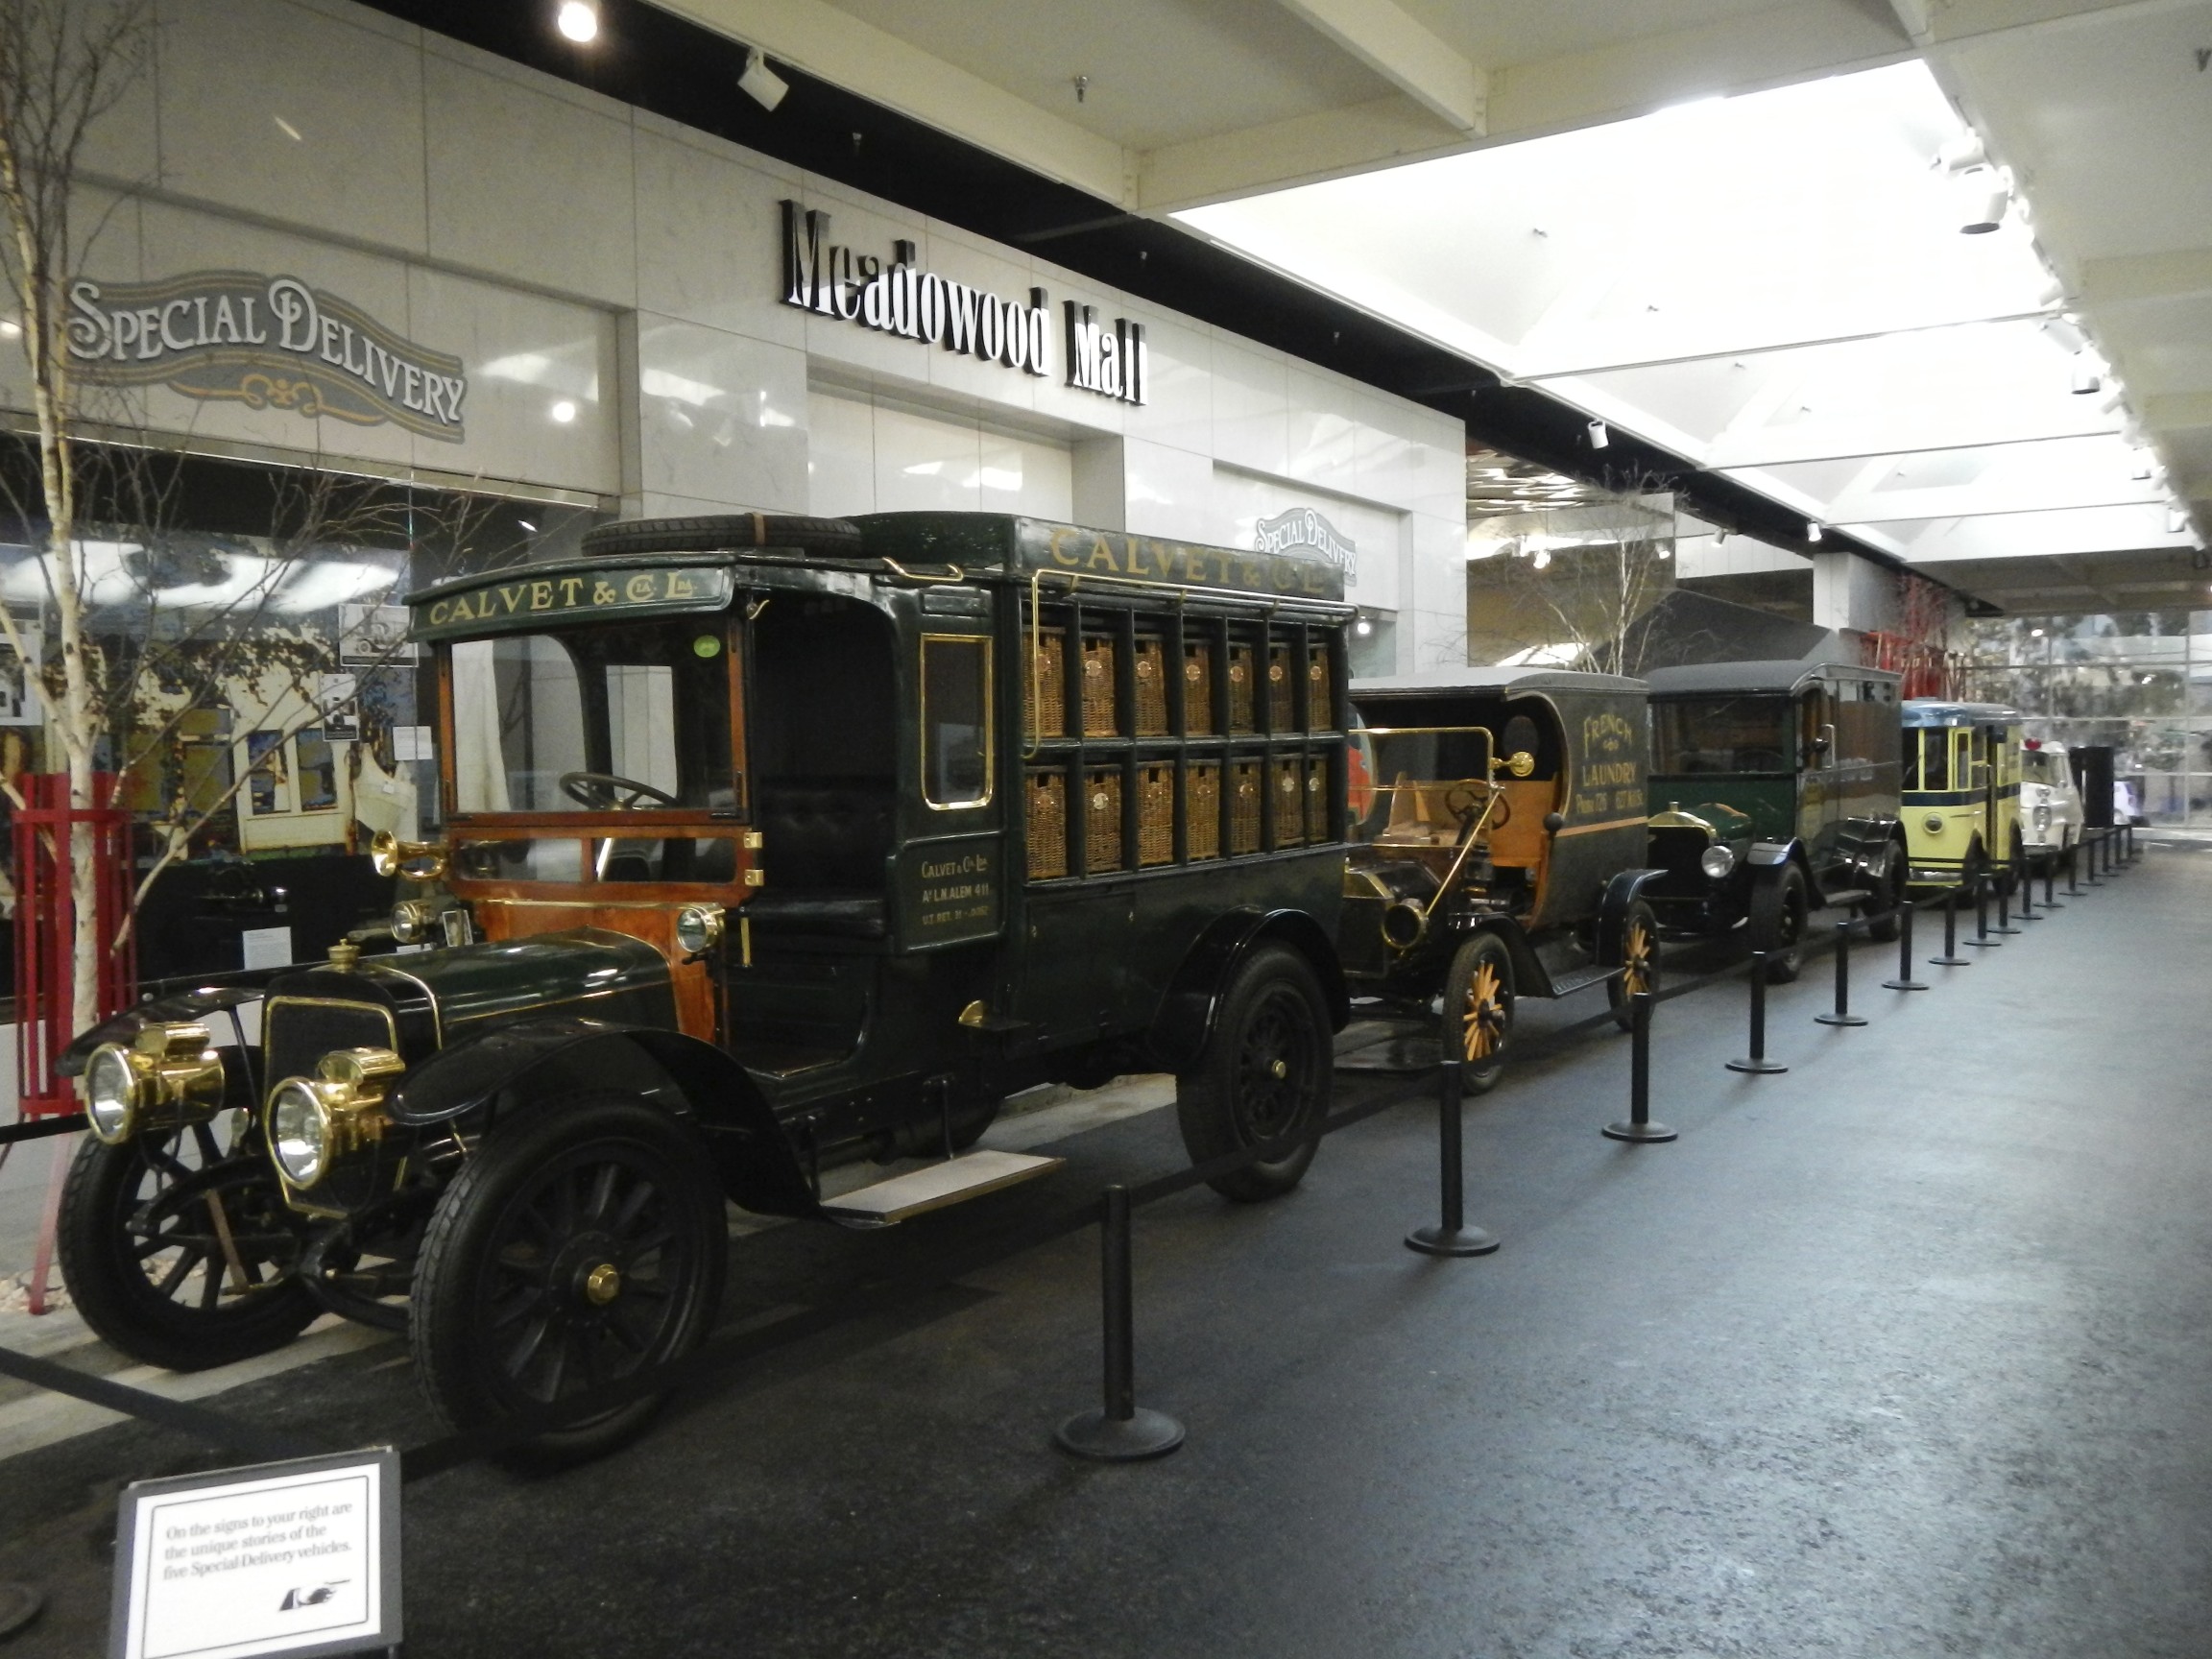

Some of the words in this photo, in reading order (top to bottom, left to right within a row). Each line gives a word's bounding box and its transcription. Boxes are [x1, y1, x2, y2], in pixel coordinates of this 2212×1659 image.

[781, 200, 1051, 377] Meadowood
[1064, 300, 1148, 406] Mall
[67, 281, 266, 361] SPECIAL
[269, 278, 465, 424] DELIVERY
[1050, 528, 1234, 585] CALVET
[430, 578, 584, 625] CALVET
[593, 581, 616, 606] &
[1582, 762, 1637, 787] LAUNDRY
[164, 1545, 187, 1561] the
[190, 1540, 237, 1557] unique
[241, 1533, 286, 1549] stories
[289, 1527, 303, 1541] of
[304, 1524, 327, 1538] the
[165, 1526, 186, 1540] On
[189, 1522, 211, 1536] the
[213, 1517, 249, 1534] signs
[252, 1514, 264, 1528] to
[266, 1511, 295, 1529] your
[299, 1504, 329, 1524] right
[331, 1503, 352, 1515] are
[162, 1565, 189, 1581] five
[190, 1558, 240, 1577] Special
[241, 1550, 294, 1569] Delivery
[297, 1540, 352, 1559] vehicles.
